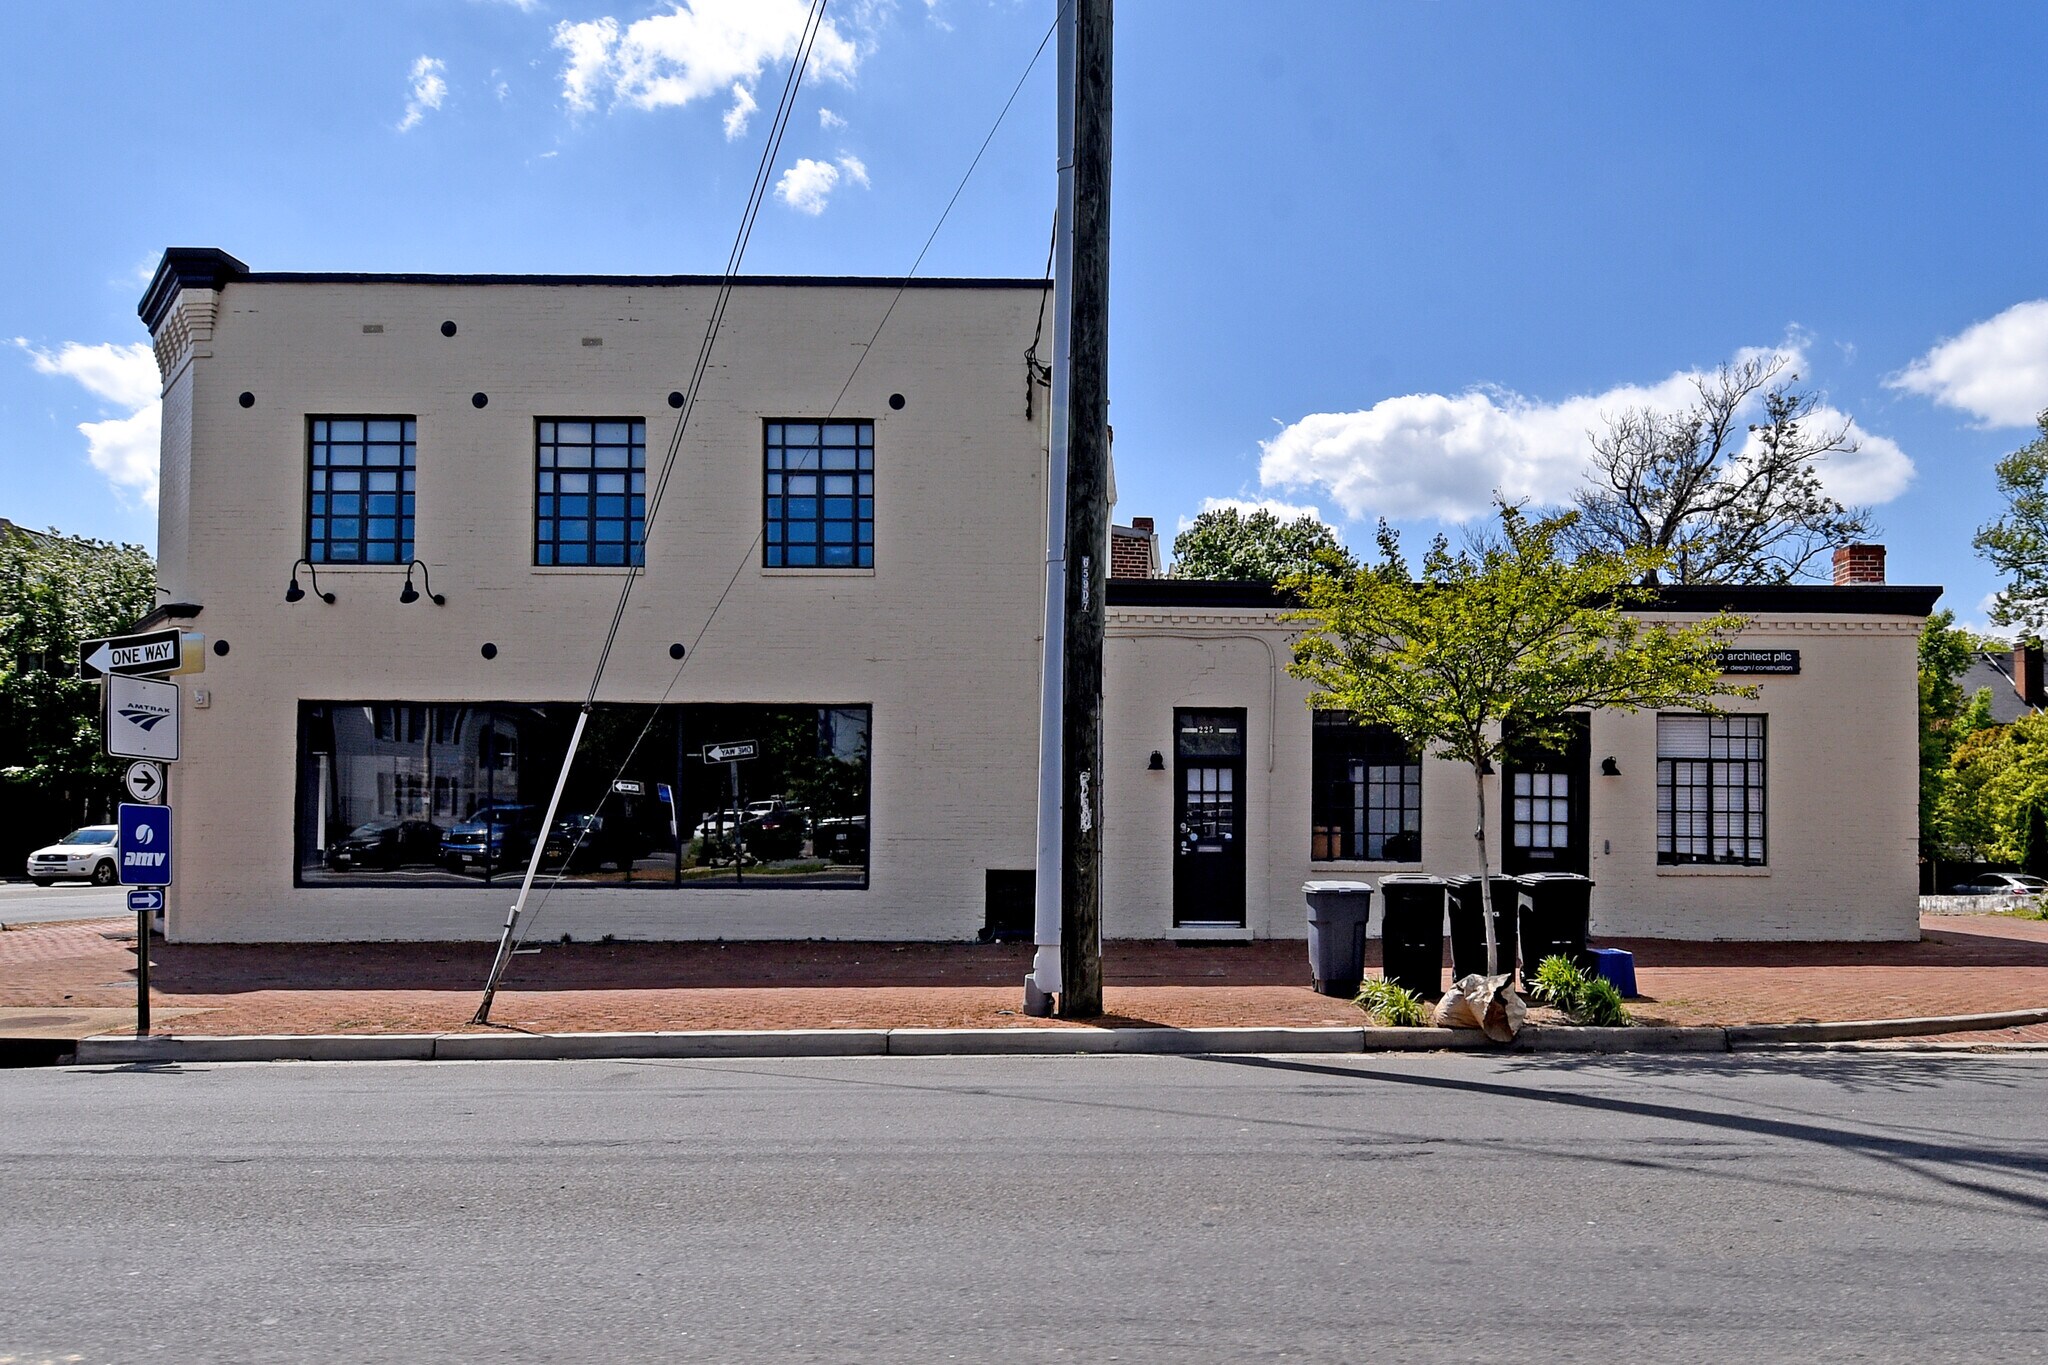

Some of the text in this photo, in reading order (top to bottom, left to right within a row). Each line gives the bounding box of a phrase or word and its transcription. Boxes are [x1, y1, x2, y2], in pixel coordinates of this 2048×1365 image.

[112, 643, 170, 665] ONE WAY
[1727, 652, 1772, 661] architect
[1774, 652, 1792, 663] pllc
[127, 702, 170, 713] AMTRAK
[1199, 725, 1213, 734] 225
